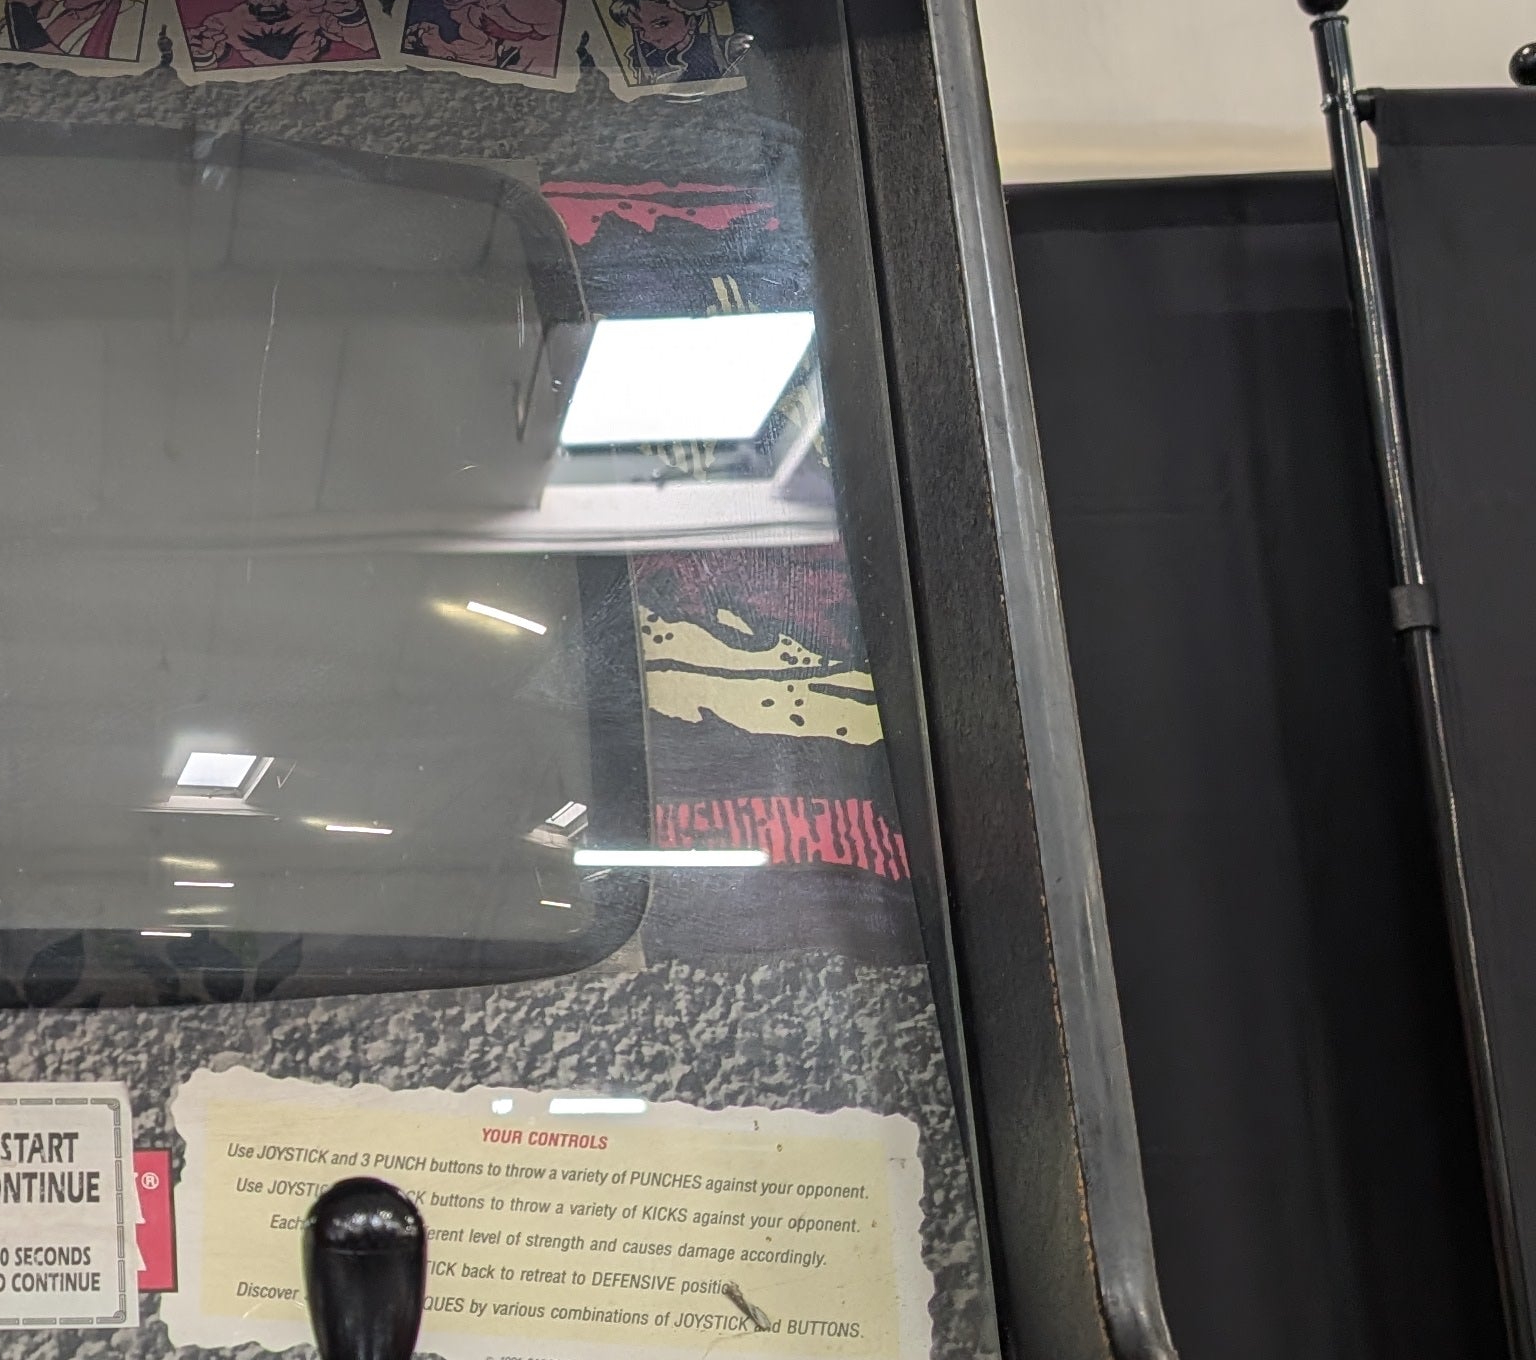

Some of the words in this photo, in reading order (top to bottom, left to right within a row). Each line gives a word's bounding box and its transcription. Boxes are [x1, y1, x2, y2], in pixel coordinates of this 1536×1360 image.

[0, 1131, 79, 1164] START
[482, 1128, 523, 1145] YOUR
[527, 1131, 609, 1150] CONTROLS
[227, 1142, 254, 1159] Use
[256, 1145, 330, 1165] JOYSTICK
[331, 1151, 359, 1167] and
[360, 1152, 371, 1167] 3
[373, 1153, 427, 1172] PUNCH
[429, 1157, 484, 1176] buttons
[487, 1162, 502, 1177] to
[505, 1163, 546, 1180] throw
[548, 1169, 558, 1180] a
[561, 1167, 609, 1187] variety
[611, 1170, 628, 1185] of
[629, 1170, 703, 1190] PUNCHES
[704, 1177, 758, 1194] against
[759, 1181, 794, 1197] your
[796, 1183, 870, 1200] opponent.
[236, 1177, 264, 1194] Use
[267, 1180, 330, 1197] JOYSTIC
[430, 1191, 485, 1210] buttons
[490, 1196, 505, 1211] to
[510, 1197, 552, 1214] throw
[555, 1203, 564, 1215] a
[569, 1202, 618, 1221] variety
[622, 1204, 637, 1219] of
[641, 1205, 689, 1223] KICKS
[692, 1210, 746, 1227] against
[749, 1215, 784, 1230] your
[787, 1217, 861, 1233] opponent.
[14, 1246, 92, 1267] SECONDS
[468, 1228, 502, 1245] level
[505, 1231, 522, 1246] of
[525, 1233, 585, 1252] strength
[589, 1238, 618, 1253] and
[622, 1241, 673, 1256] causes
[677, 1242, 736, 1263] damage
[740, 1249, 827, 1268] accordingly.
[11, 1271, 101, 1293] CONTINUE
[462, 1262, 495, 1280] back
[500, 1266, 515, 1281] to
[519, 1268, 567, 1285] retreat
[571, 1271, 586, 1286] to
[591, 1271, 677, 1292] DEFENSIVE
[680, 1278, 735, 1296] positio
[236, 1281, 300, 1300] Discover
[469, 1298, 488, 1317] by
[492, 1301, 545, 1318] various
[550, 1305, 649, 1326] combinations
[654, 1311, 671, 1327] of
[673, 1312, 750, 1332] JOYSTICK
[787, 1319, 865, 1339] BUTTONS.
